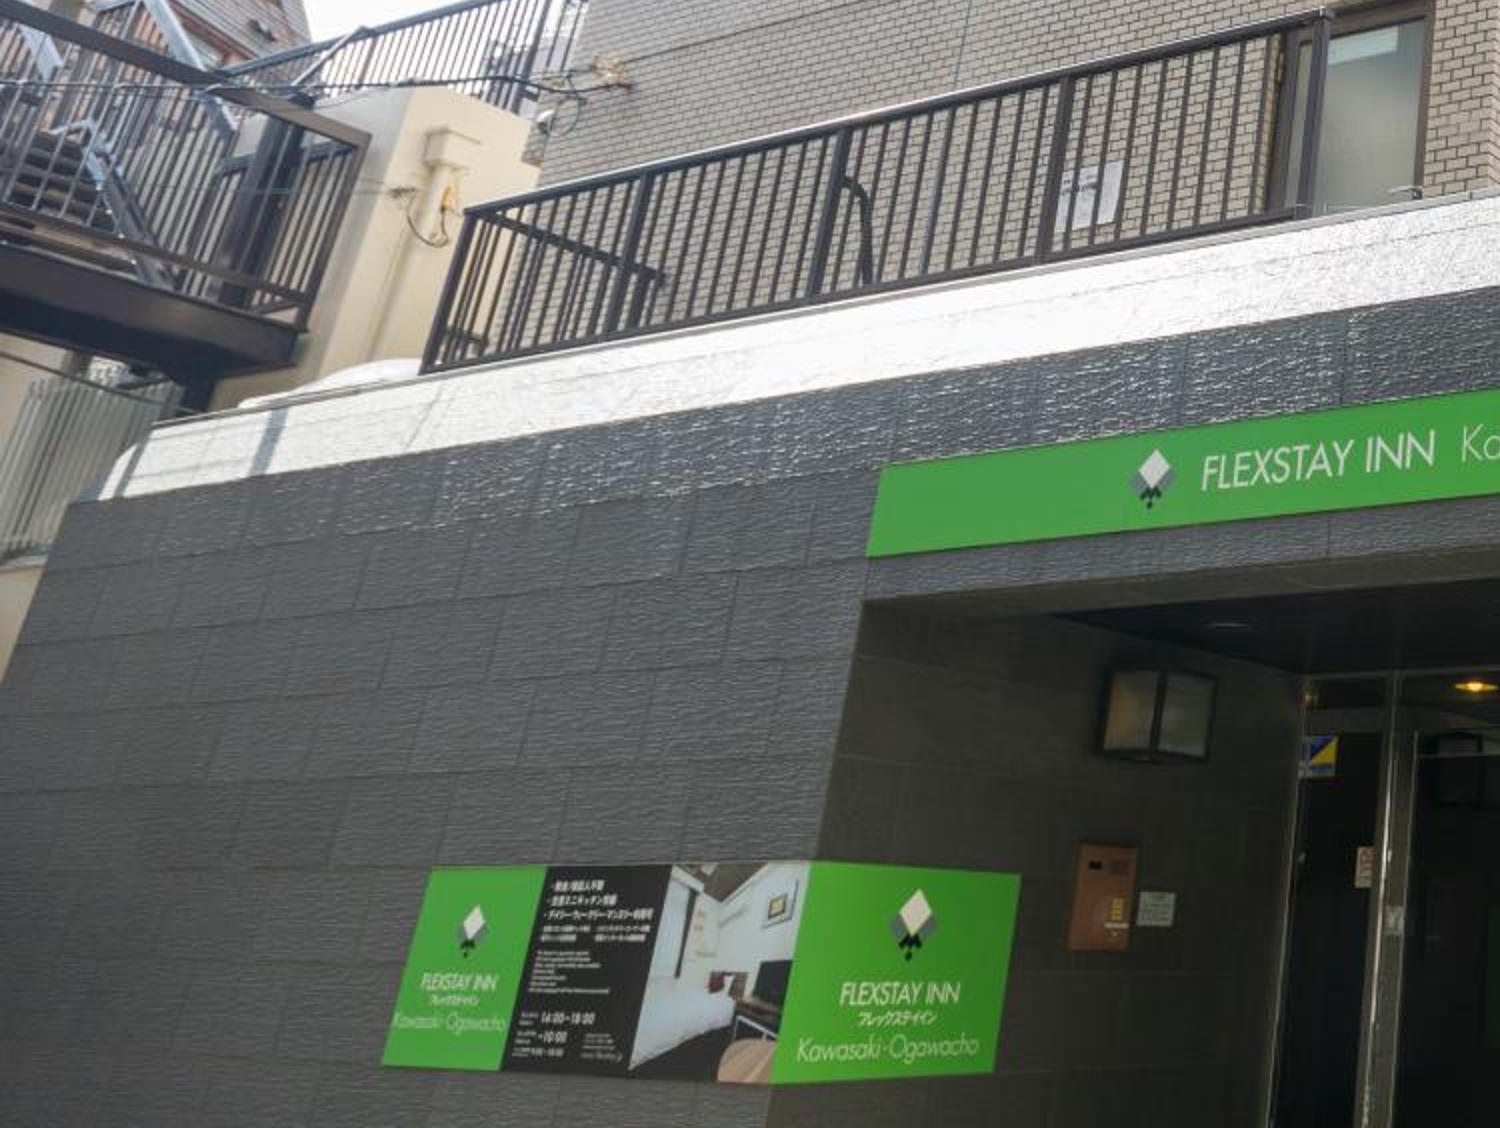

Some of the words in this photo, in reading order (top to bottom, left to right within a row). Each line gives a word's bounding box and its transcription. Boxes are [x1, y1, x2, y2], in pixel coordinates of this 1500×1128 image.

[1201, 439, 1354, 491] FLEXSTAY
[1365, 429, 1436, 474] INN
[838, 981, 924, 1007] FLEXSTAY
[925, 981, 961, 1005] INN
